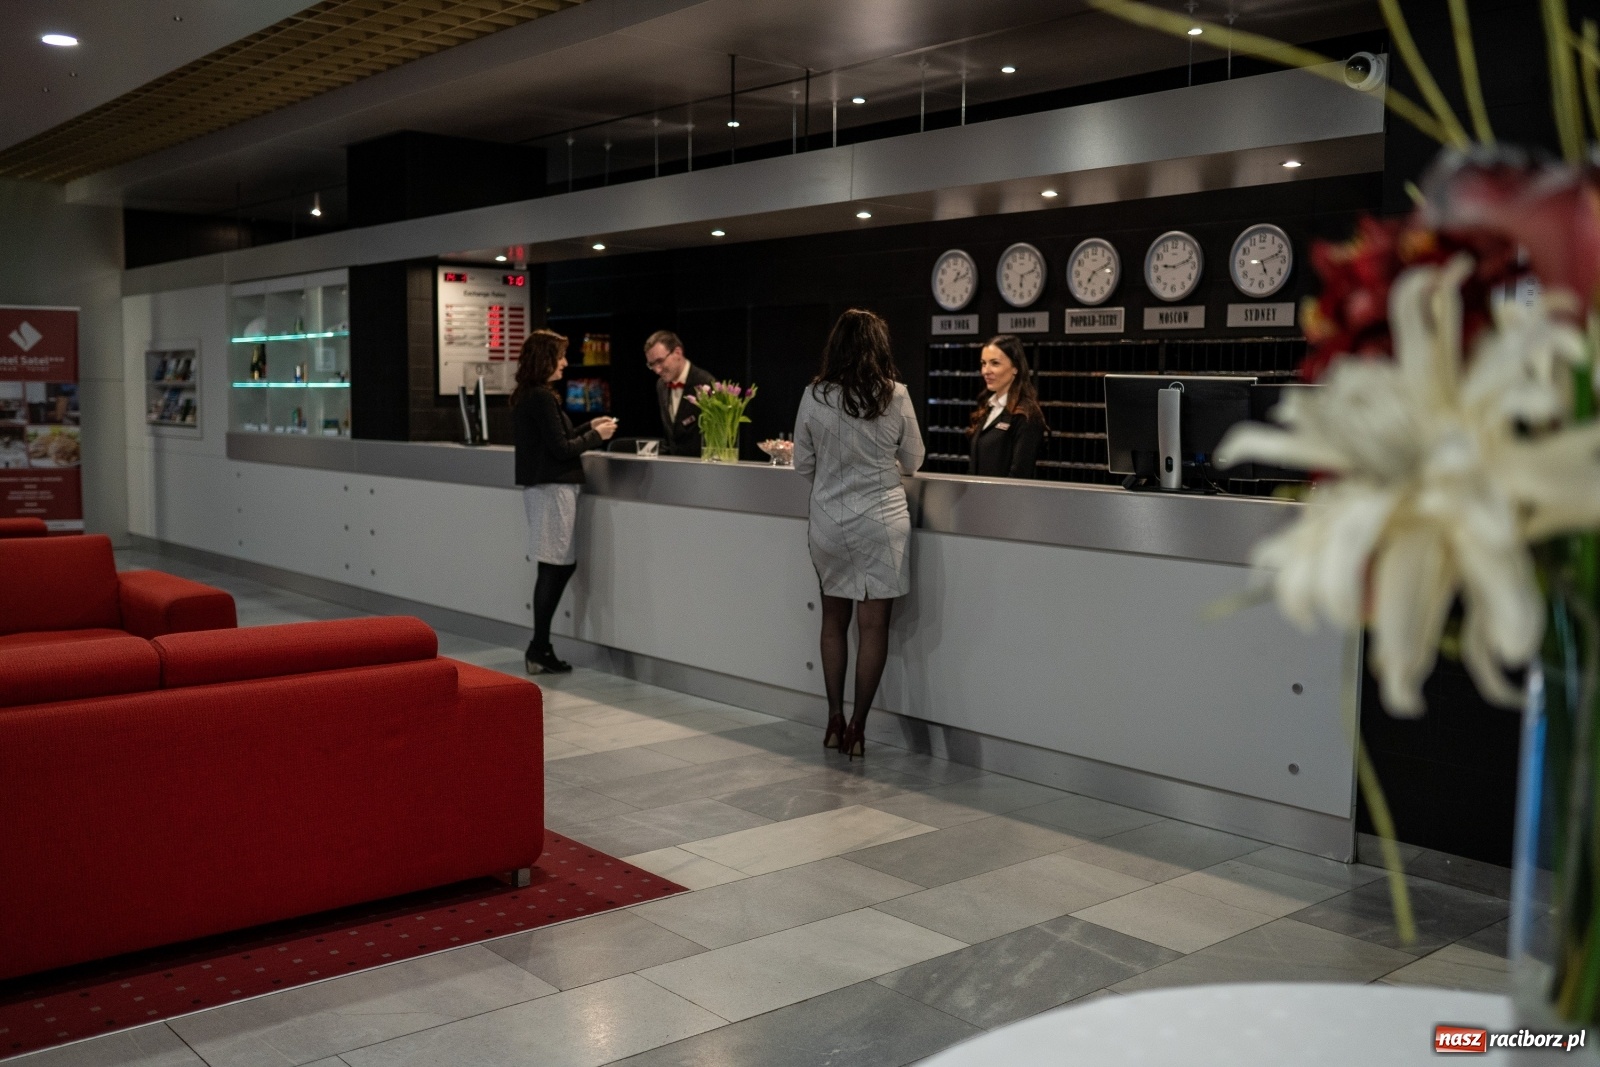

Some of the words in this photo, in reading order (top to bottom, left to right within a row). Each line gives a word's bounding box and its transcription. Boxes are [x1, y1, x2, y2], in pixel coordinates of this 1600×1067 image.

[1259, 233, 1267, 243] 12
[1272, 236, 1274, 244] 1
[1163, 244, 1168, 252] 11
[1171, 240, 1178, 249] 12
[1278, 244, 1283, 253] 2
[1188, 250, 1193, 259] 2
[1242, 246, 1250, 256] 10
[1156, 252, 1163, 261] 10
[1281, 255, 1286, 264] 3
[1191, 261, 1196, 270] 3
[1239, 259, 1245, 268] 9
[1154, 264, 1158, 273] 9
[1277, 268, 1281, 276] 4
[1188, 273, 1192, 281] 4
[1242, 270, 1248, 279] 8
[1156, 276, 1161, 284] 8
[1250, 278, 1255, 287] 7
[1258, 280, 1264, 289] 6
[1270, 277, 1274, 286] 5
[1162, 282, 1167, 290] 7
[1171, 284, 1176, 292] 6
[1181, 282, 1185, 290] 5
[1159, 311, 1189, 324] MOSCOW
[1245, 308, 1276, 321] SYDNEY
[941, 320, 952, 330] NEW
[954, 320, 970, 330] YORK
[1011, 318, 1035, 329] LONDON
[1070, 314, 1117, 327] POPRAD-TATRY
